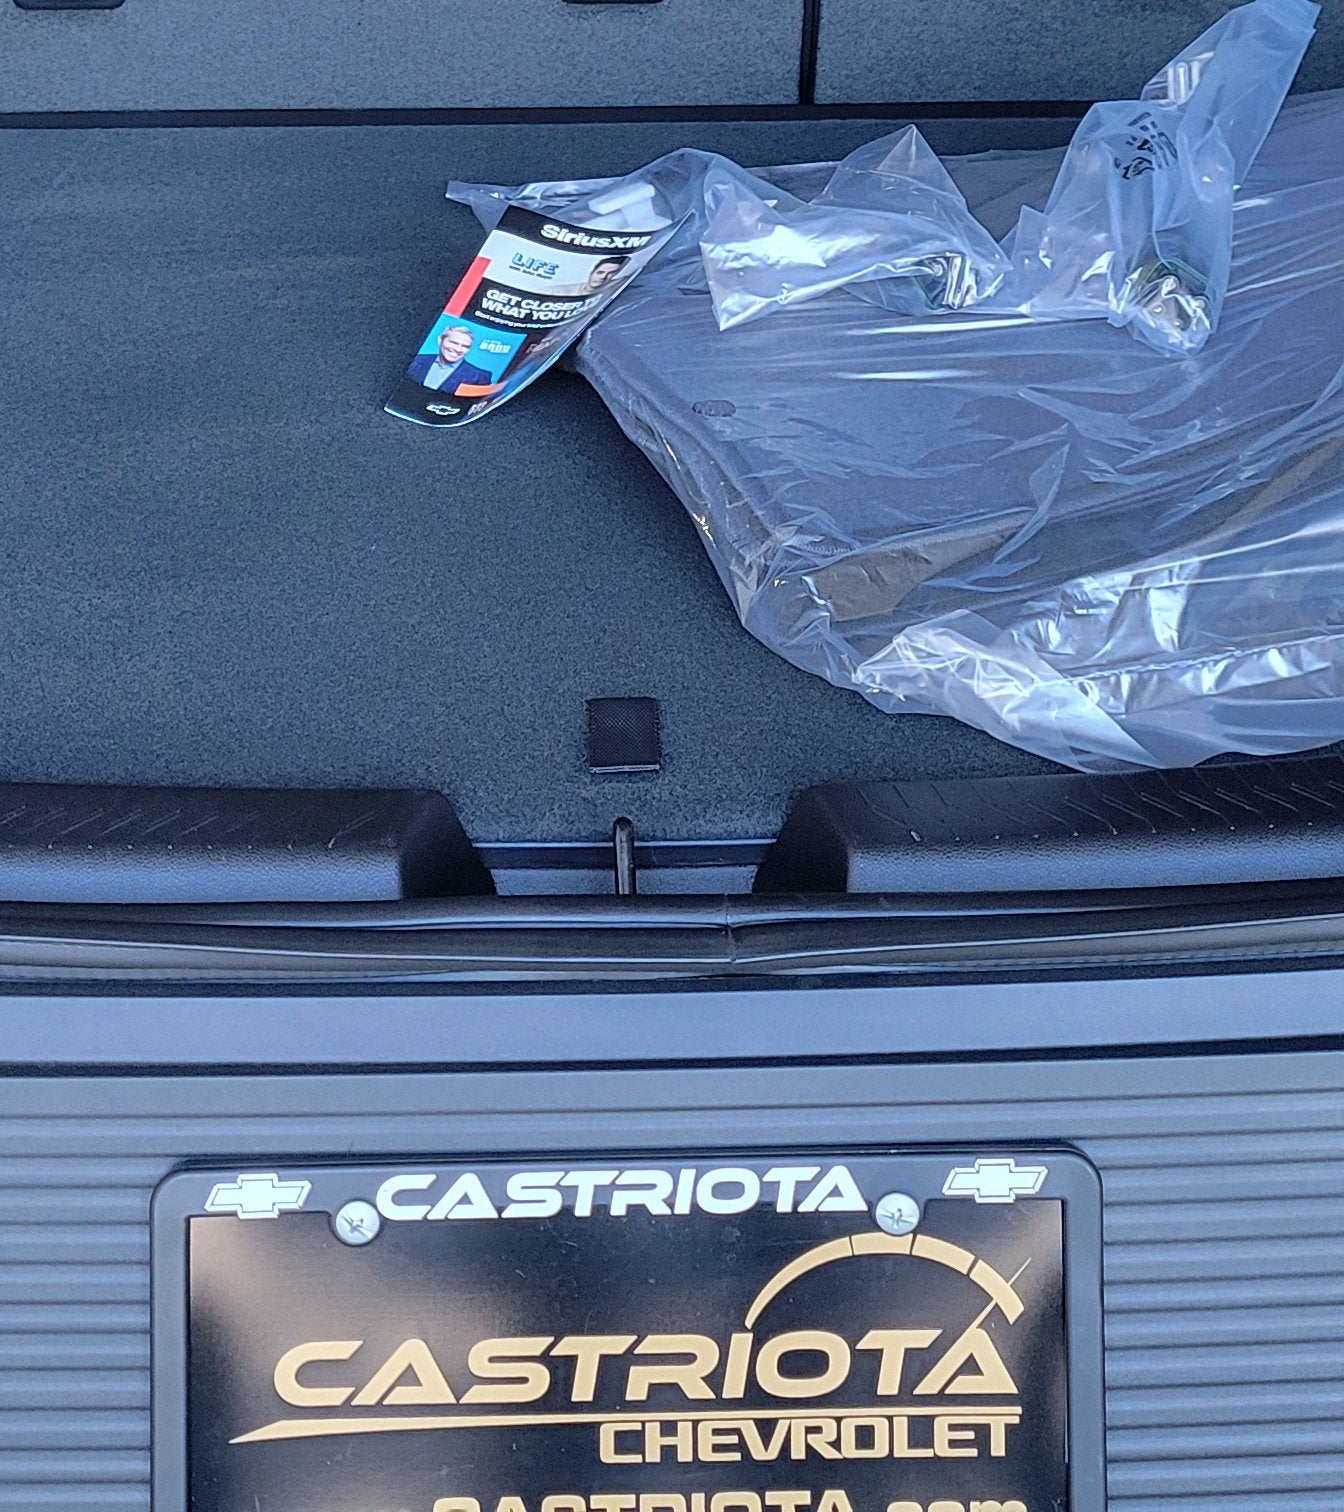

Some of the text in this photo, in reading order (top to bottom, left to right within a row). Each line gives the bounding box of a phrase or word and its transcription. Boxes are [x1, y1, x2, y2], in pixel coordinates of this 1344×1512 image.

[540, 223, 652, 249] SiriusXM
[511, 251, 560, 275] LIFE
[481, 297, 531, 321] WHAT
[531, 309, 565, 321] YOU
[485, 289, 521, 306] GET
[520, 298, 583, 312] CLOSER
[375, 1167, 869, 1220] CASTRIOTA
[273, 1326, 1020, 1406] CASTRIOTA
[599, 1414, 1020, 1464] CHEVROLET
